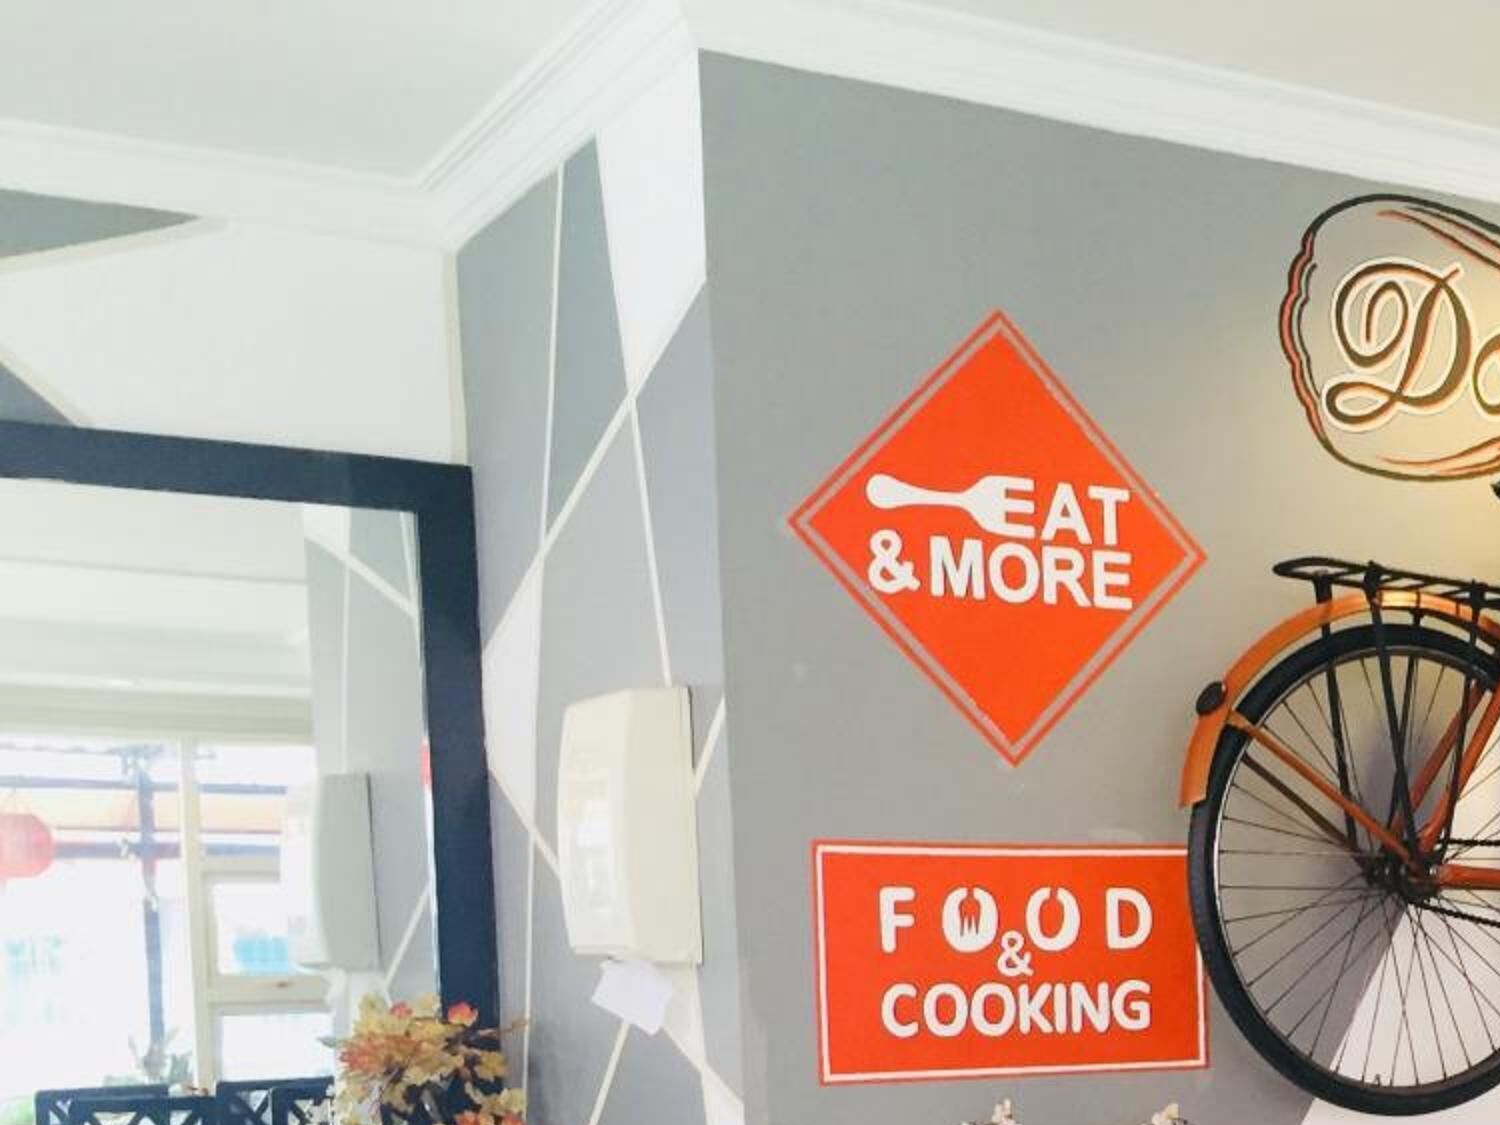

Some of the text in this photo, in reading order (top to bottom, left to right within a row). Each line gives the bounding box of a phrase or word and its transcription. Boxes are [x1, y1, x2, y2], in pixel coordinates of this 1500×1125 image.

[975, 474, 1131, 546] EAT
[867, 529, 1133, 611] & MORE
[879, 886, 1153, 953] FOOD
[997, 930, 1035, 977] &
[881, 979, 1152, 1038] COOKING
